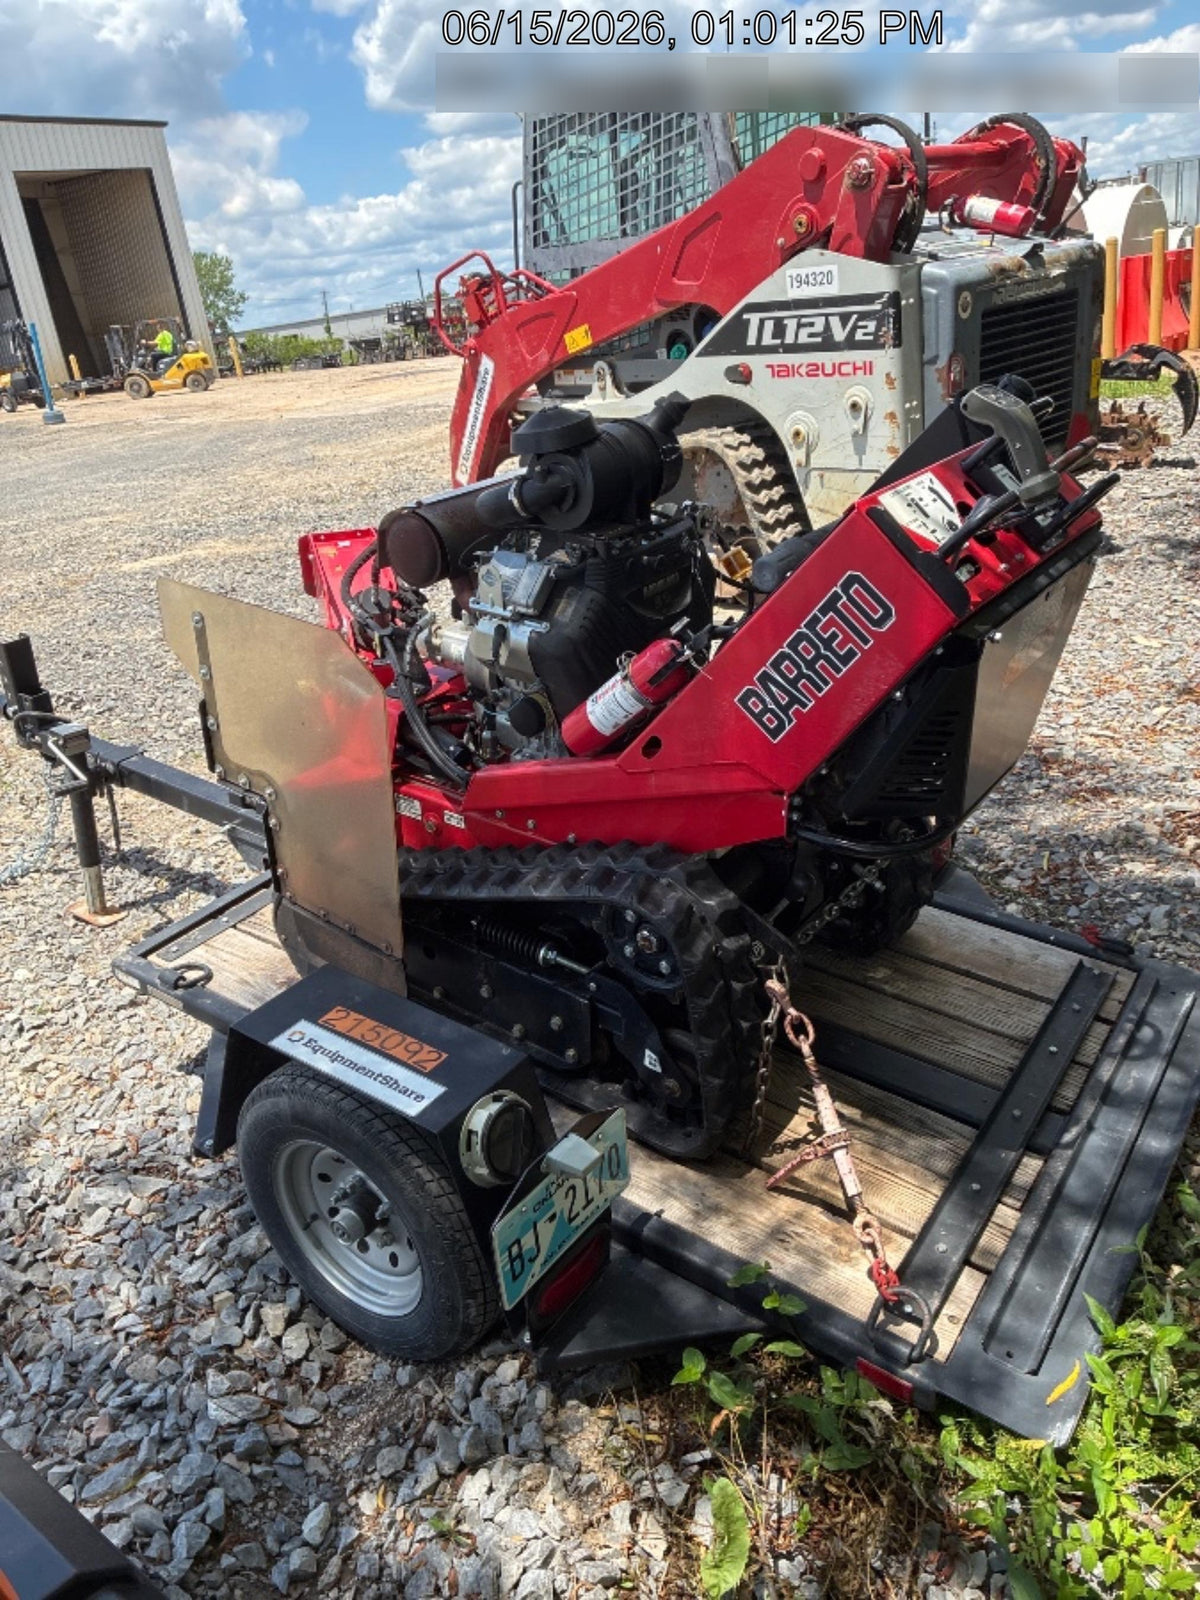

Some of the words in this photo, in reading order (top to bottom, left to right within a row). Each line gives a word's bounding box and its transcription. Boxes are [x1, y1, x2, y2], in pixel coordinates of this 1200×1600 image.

[788, 270, 834, 290] 194320
[734, 570, 896, 743] BARRETO
[302, 1036, 426, 1104] EquipmentShare
[321, 1006, 445, 1072] 215092
